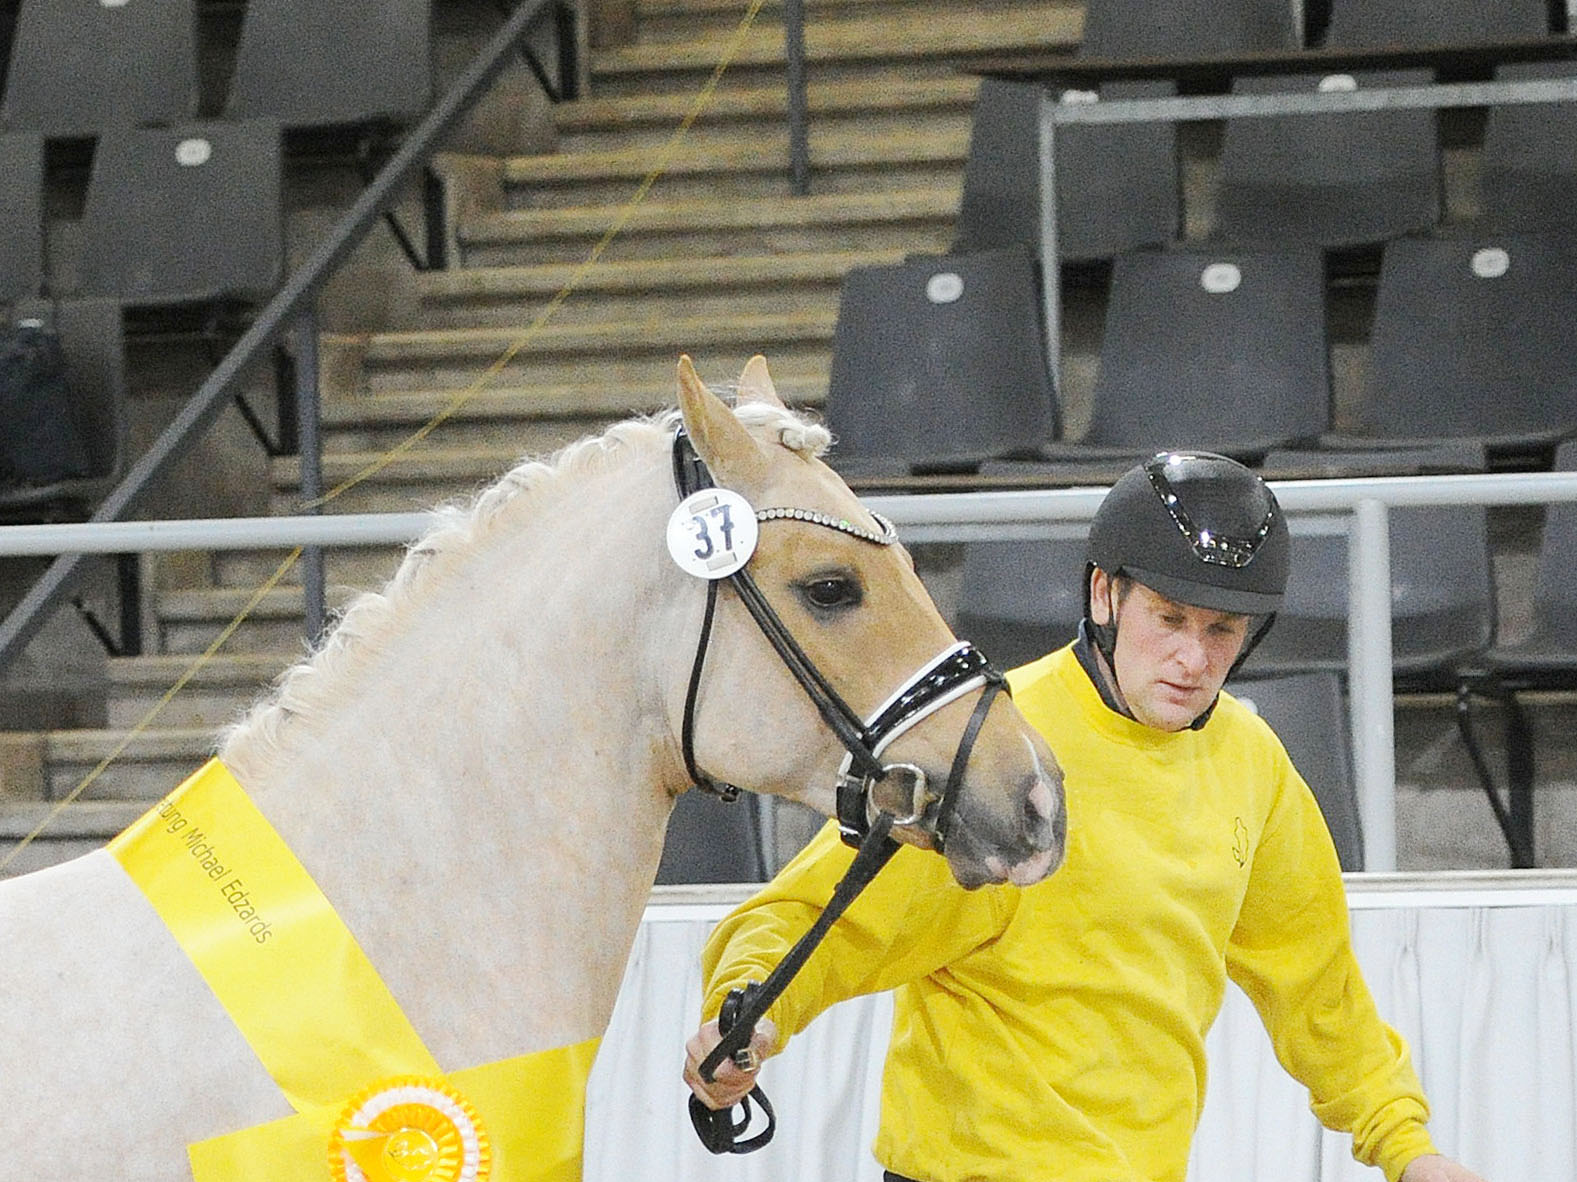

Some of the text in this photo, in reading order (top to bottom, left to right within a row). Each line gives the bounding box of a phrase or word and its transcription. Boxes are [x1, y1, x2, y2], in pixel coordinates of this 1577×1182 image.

[692, 504, 734, 559] 37
[181, 827, 233, 882] Michael
[221, 878, 272, 944] Edzards
